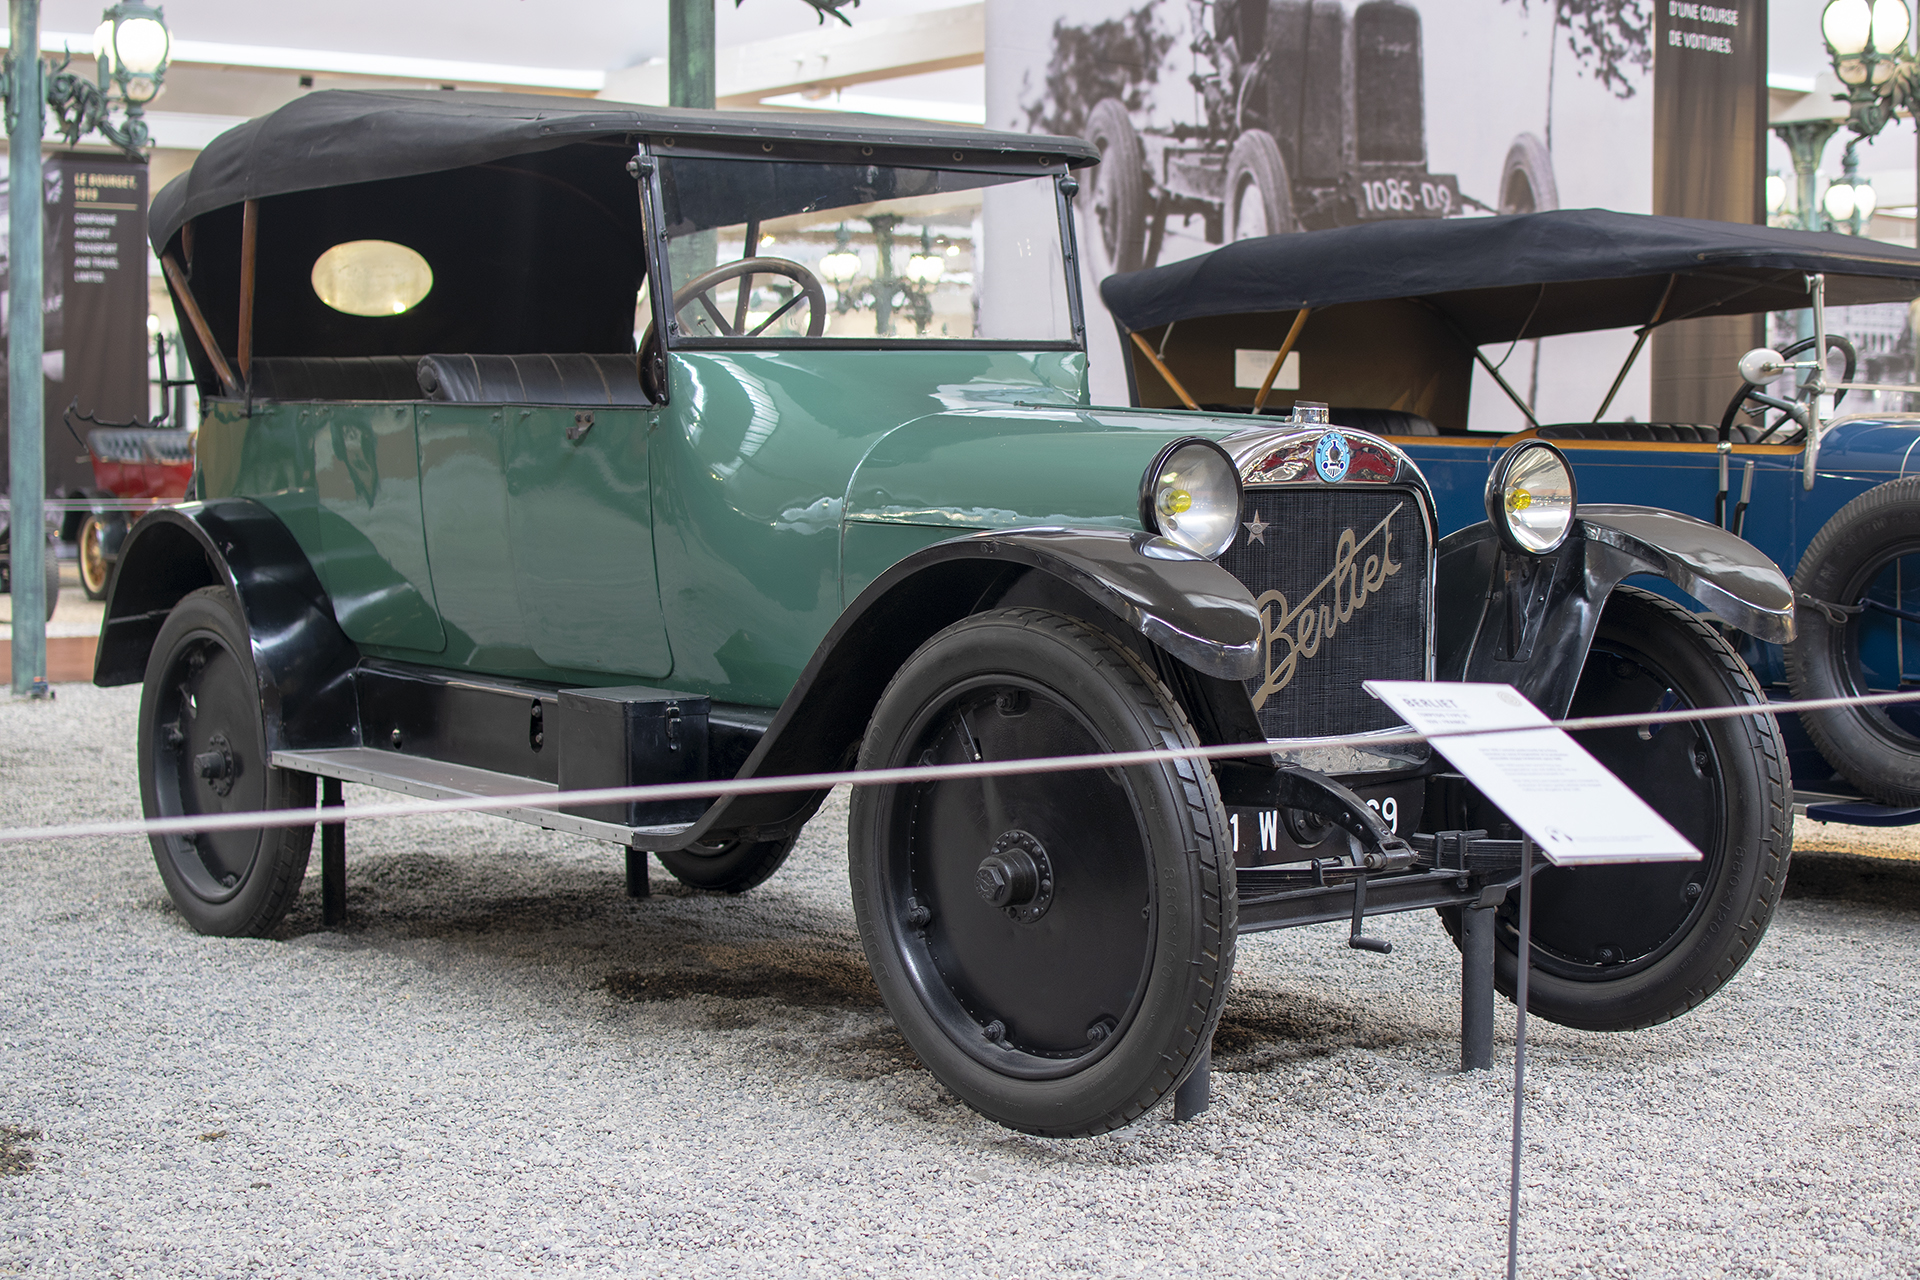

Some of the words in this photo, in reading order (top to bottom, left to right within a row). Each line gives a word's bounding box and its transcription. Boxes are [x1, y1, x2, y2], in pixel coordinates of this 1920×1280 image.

[1669, 0, 1699, 20] D'UNE
[1700, 5, 1738, 26] COURSE
[1669, 30, 1682, 47] DE
[74, 172, 87, 186] LE
[75, 187, 98, 201] 1919
[74, 256, 91, 268] AND
[1251, 501, 1403, 712] Berliet
[1402, 698, 1458, 708] BERLIET
[1258, 809, 1278, 852] W
